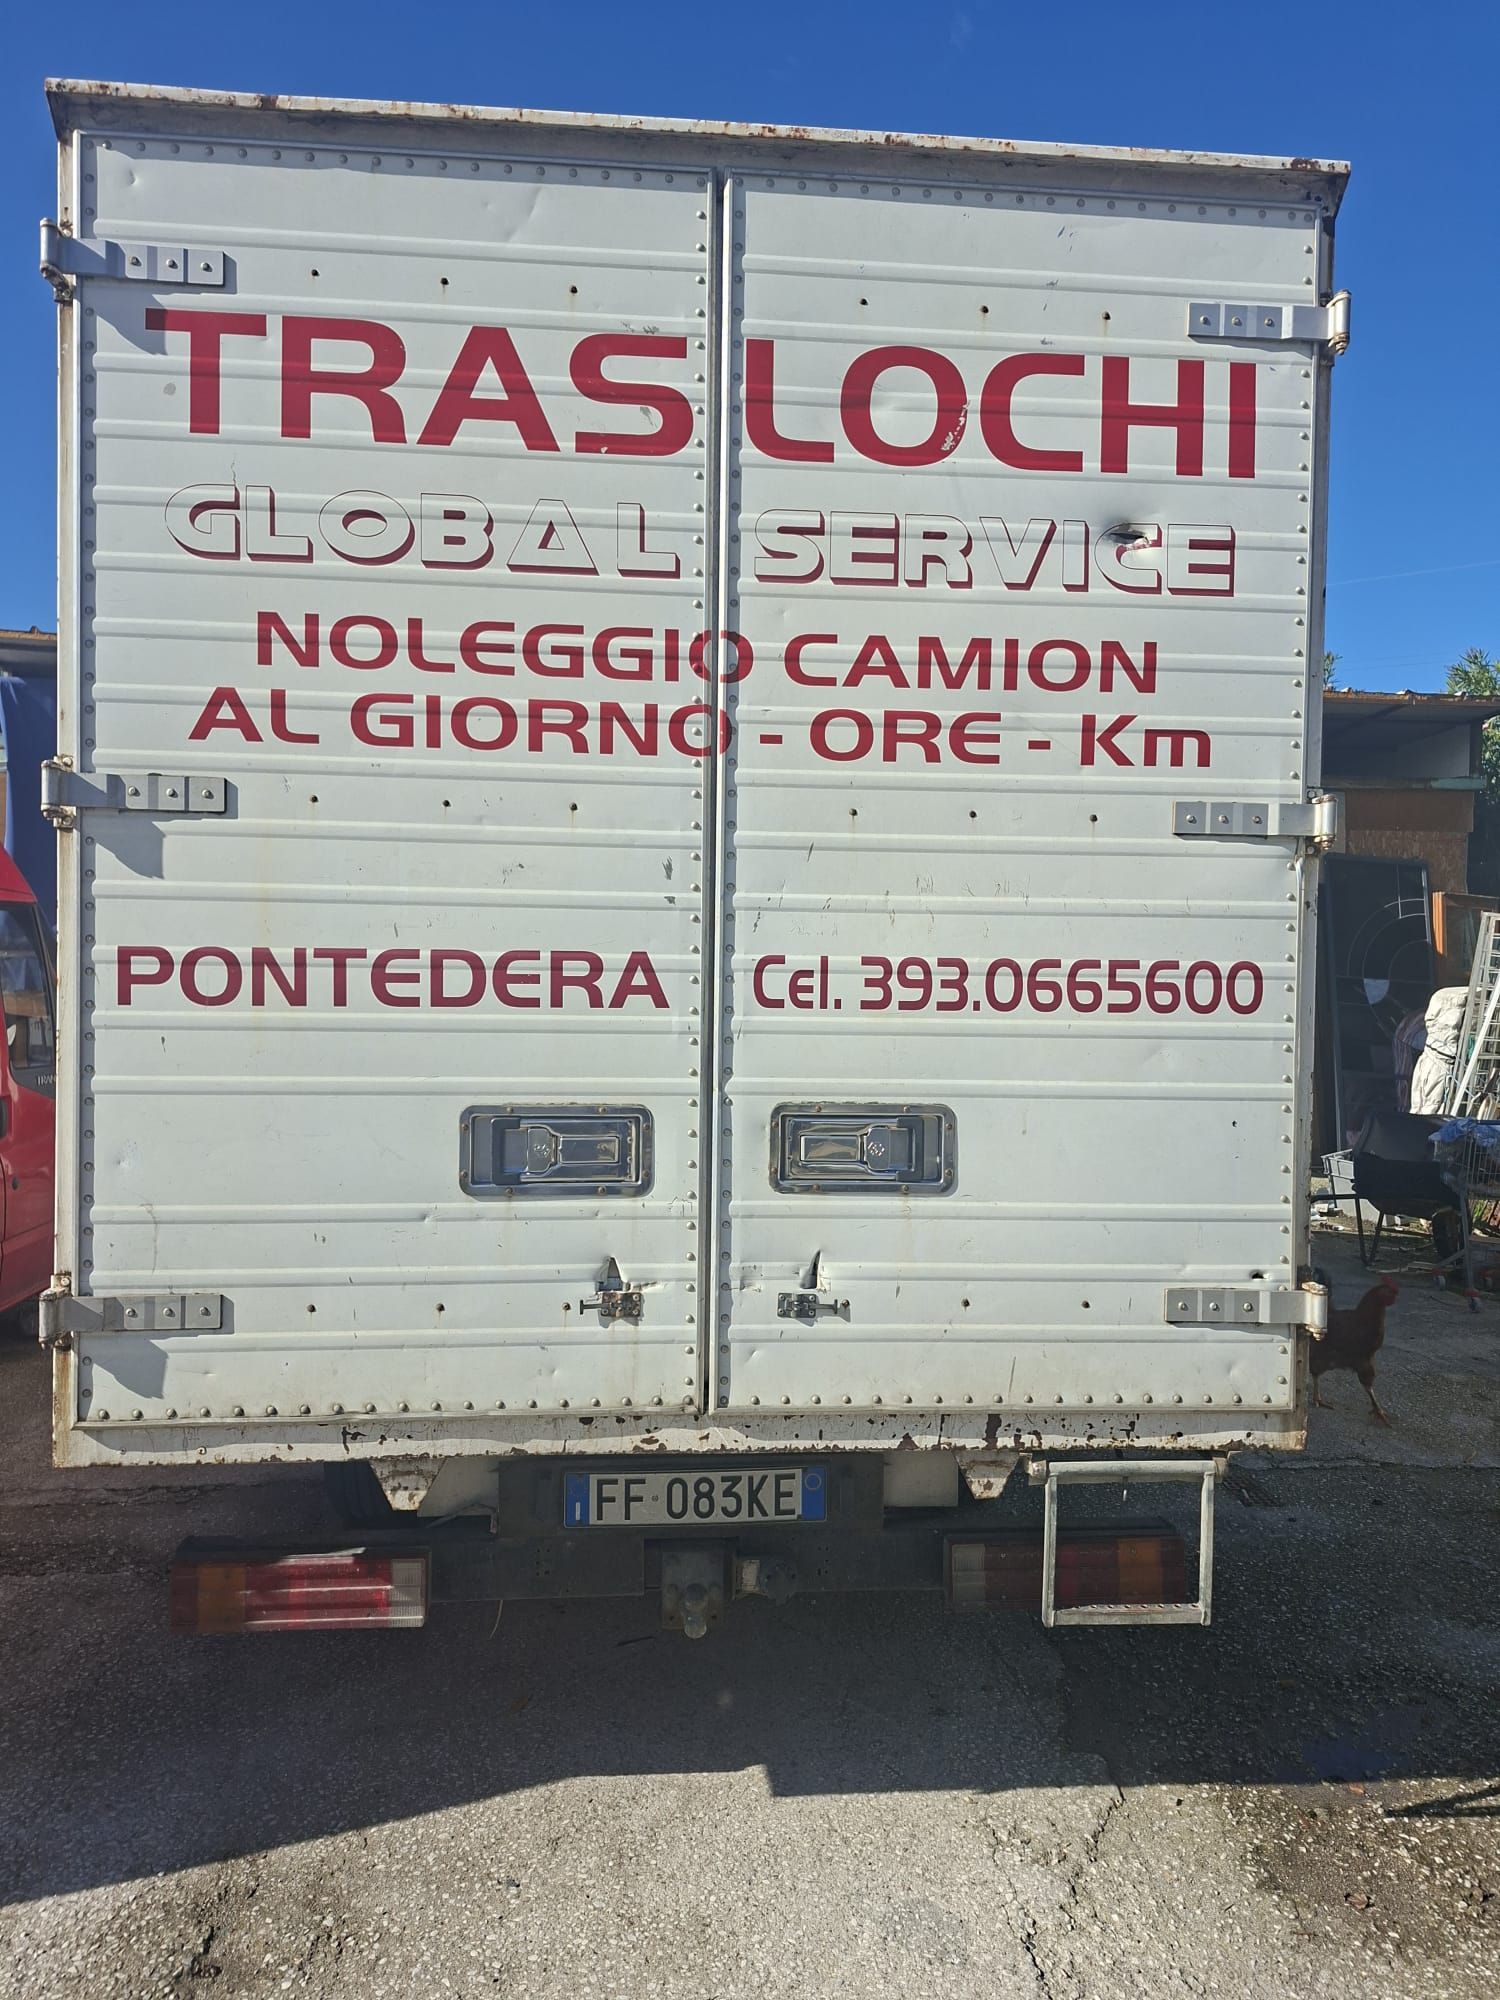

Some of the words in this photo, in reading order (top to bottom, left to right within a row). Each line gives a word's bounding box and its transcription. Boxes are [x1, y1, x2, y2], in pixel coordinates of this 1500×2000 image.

[145, 308, 1256, 479] TRASLOCHI
[164, 483, 682, 580] GLOBAL
[753, 509, 1236, 598] SERVICE
[257, 611, 755, 684] NOLEGGIO
[784, 633, 1157, 694] CAMION
[187, 687, 320, 744] AL
[350, 693, 732, 758] GIORNO
[810, 709, 1002, 765] ORE
[1080, 714, 1211, 768] Km
[117, 946, 670, 1009] PONTEDERA
[860, 956, 1264, 1015] 393.0665600
[596, 1478, 647, 1521] FF
[666, 1473, 797, 1520] 083KE
